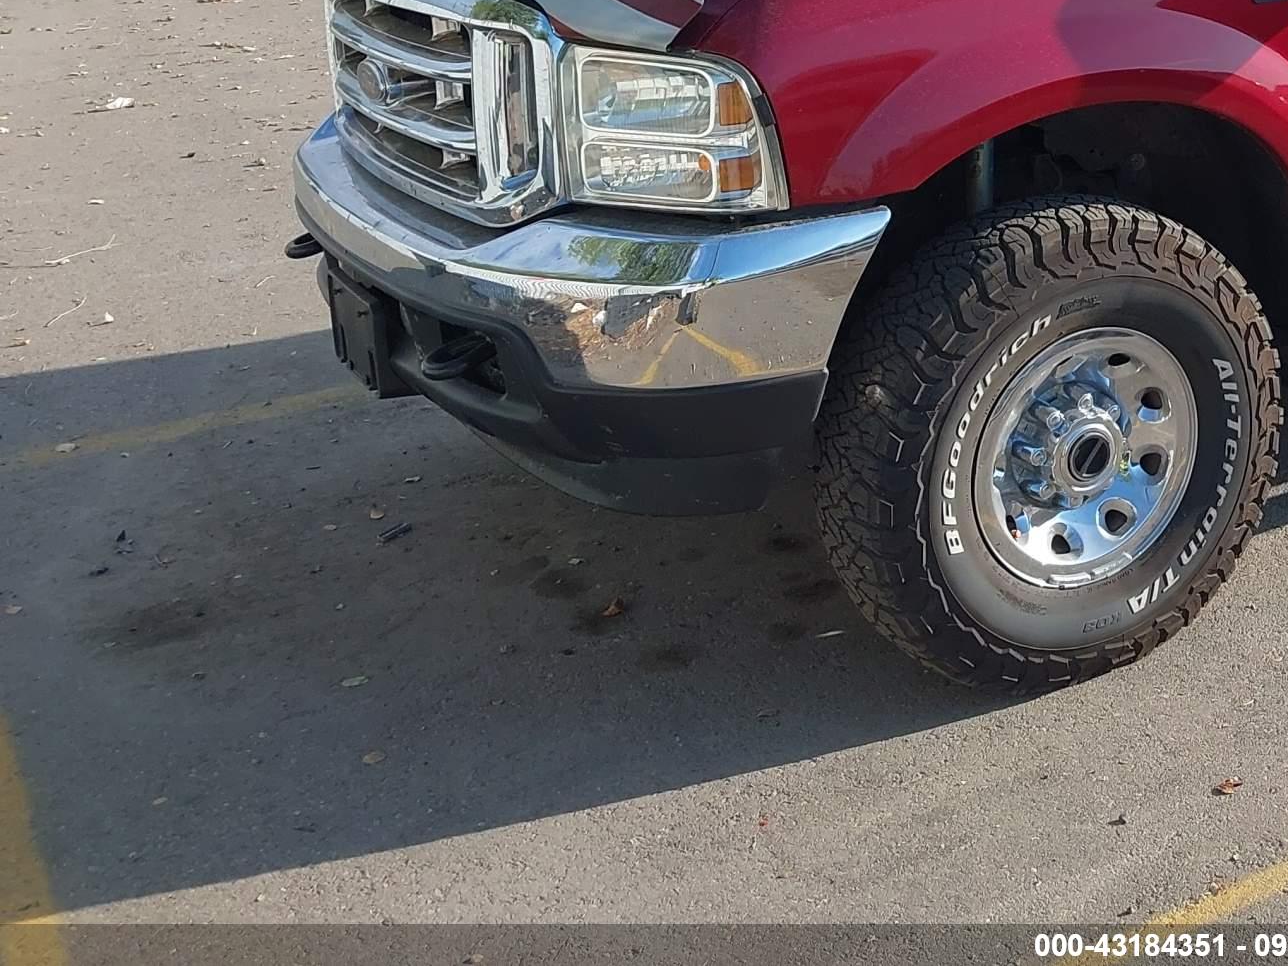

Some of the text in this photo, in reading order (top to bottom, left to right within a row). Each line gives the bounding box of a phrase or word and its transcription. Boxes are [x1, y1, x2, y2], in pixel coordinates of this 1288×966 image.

[940, 314, 1053, 555] BFGoodrich
[1180, 358, 1243, 567] All-Terrain
[1127, 565, 1182, 616] T/A
